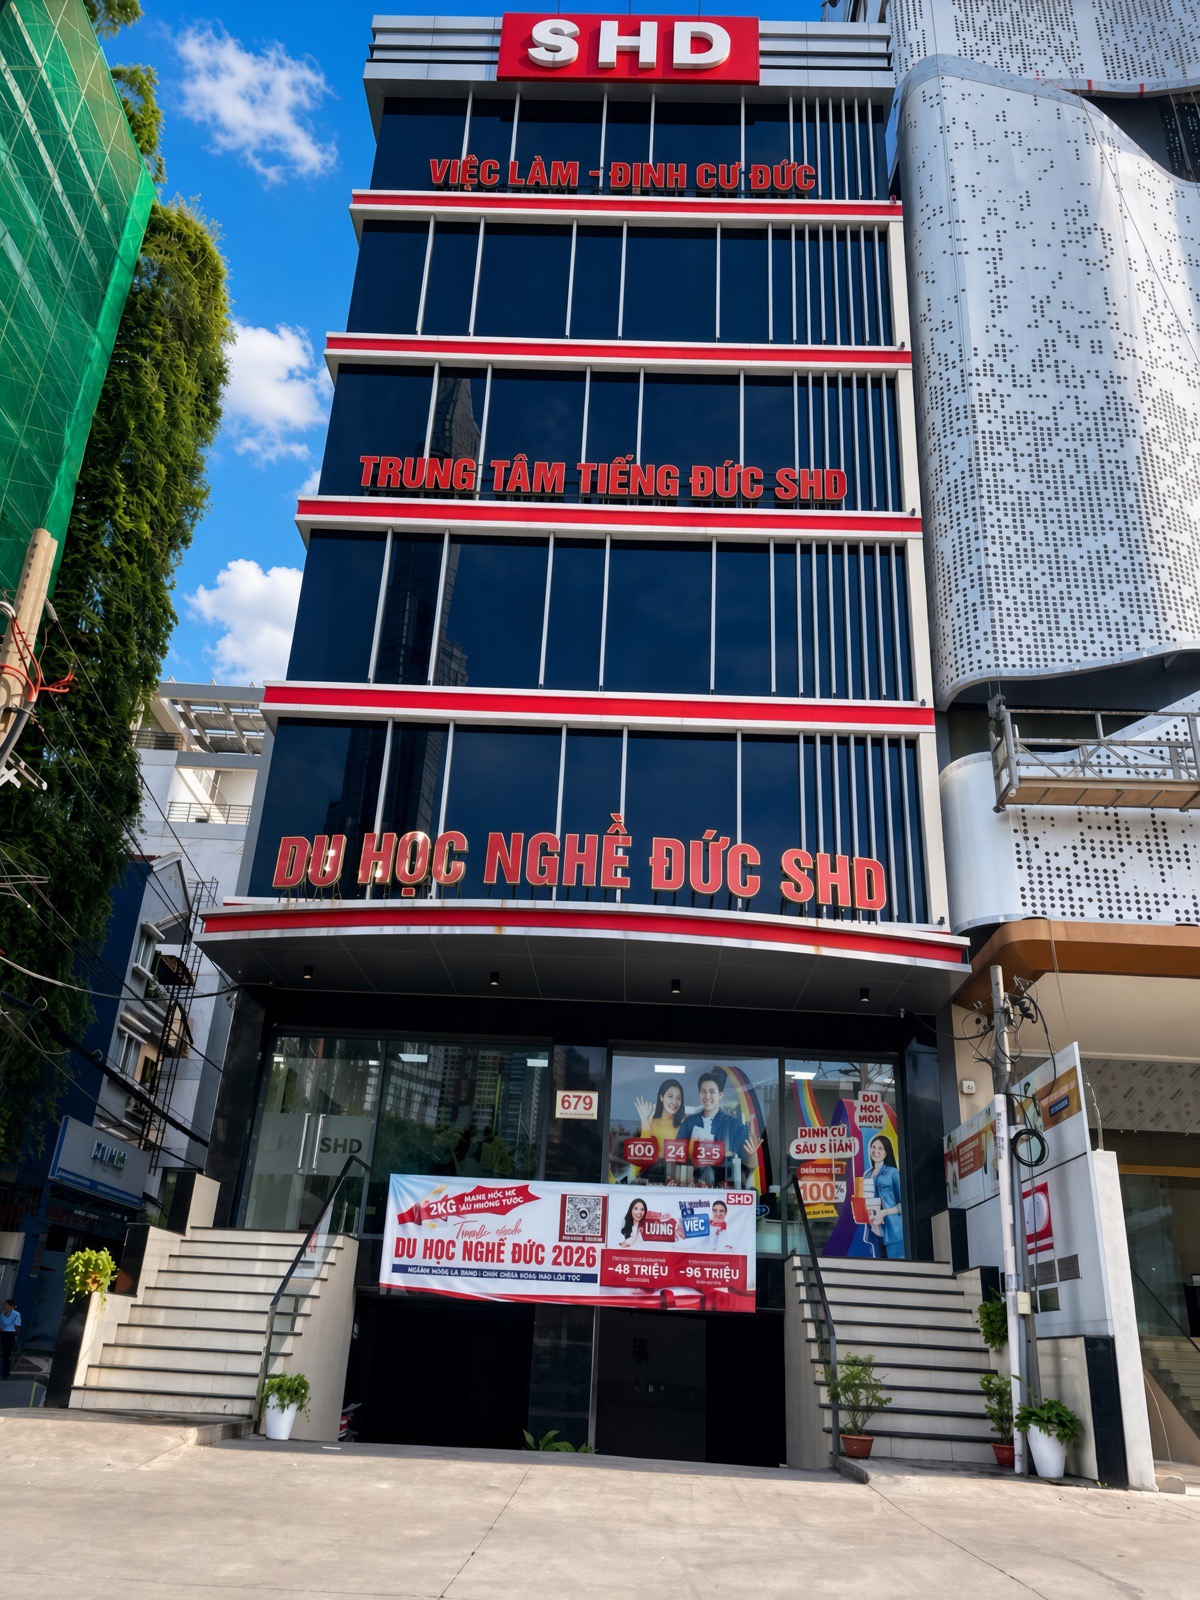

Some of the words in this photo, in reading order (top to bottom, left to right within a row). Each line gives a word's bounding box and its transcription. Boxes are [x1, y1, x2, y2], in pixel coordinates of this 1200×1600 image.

[528, 18, 731, 70] SHD
[429, 154, 500, 191] VIỆC
[507, 155, 580, 187] LÀM
[696, 161, 742, 189] CƯ
[748, 158, 816, 190] ĐỨC
[359, 455, 477, 490] TRUNG
[490, 453, 566, 493] TÂM
[576, 454, 680, 496] TIẾNG
[689, 459, 764, 499] ĐỨC
[774, 467, 848, 500] SHD
[271, 833, 347, 889] DU
[357, 830, 469, 898] HỌC
[483, 813, 633, 889] NGHỀ
[649, 829, 761, 899] ĐỨC
[779, 847, 887, 911] SHD
[561, 1094, 593, 1111] 679
[862, 1094, 878, 1103] DU
[319, 1136, 363, 1154] SHD
[627, 1143, 655, 1157] 100
[667, 1145, 686, 1158] 24
[697, 1147, 721, 1159] 3-5
[429, 1199, 456, 1216] 2KG
[728, 1194, 752, 1204] SHD
[394, 1237, 418, 1259] DU
[422, 1239, 457, 1265] HỌC
[511, 1238, 546, 1266] ĐỨC
[551, 1245, 597, 1268] 2026
[633, 1262, 669, 1279] TRIỆU
[704, 1266, 740, 1282] TRIỆU
